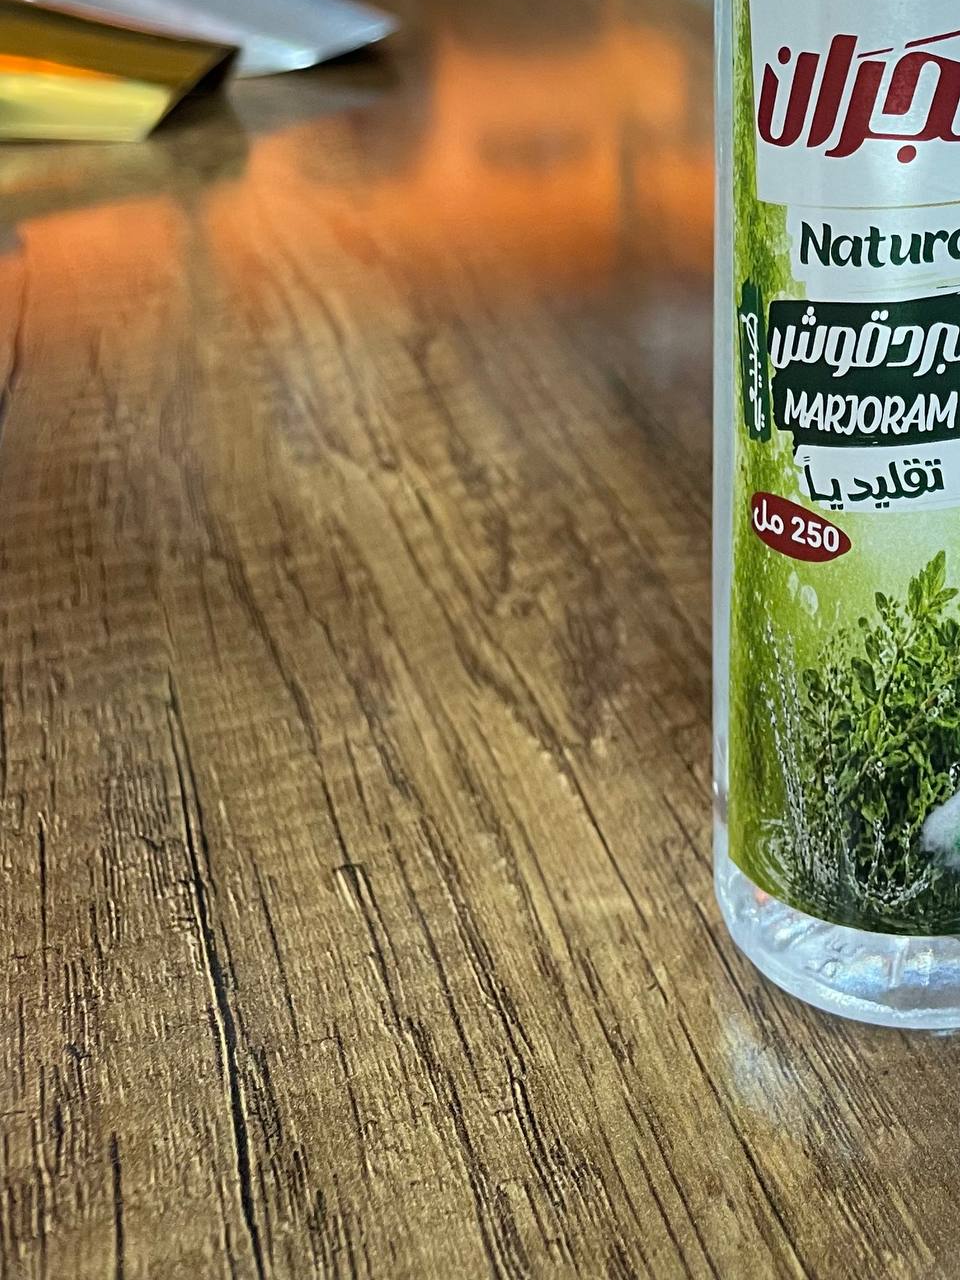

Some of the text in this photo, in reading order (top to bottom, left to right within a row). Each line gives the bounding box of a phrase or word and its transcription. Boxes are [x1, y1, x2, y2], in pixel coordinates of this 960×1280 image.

[783, 389, 957, 435] MARJORAM
[752, 499, 840, 553] 250 مل
